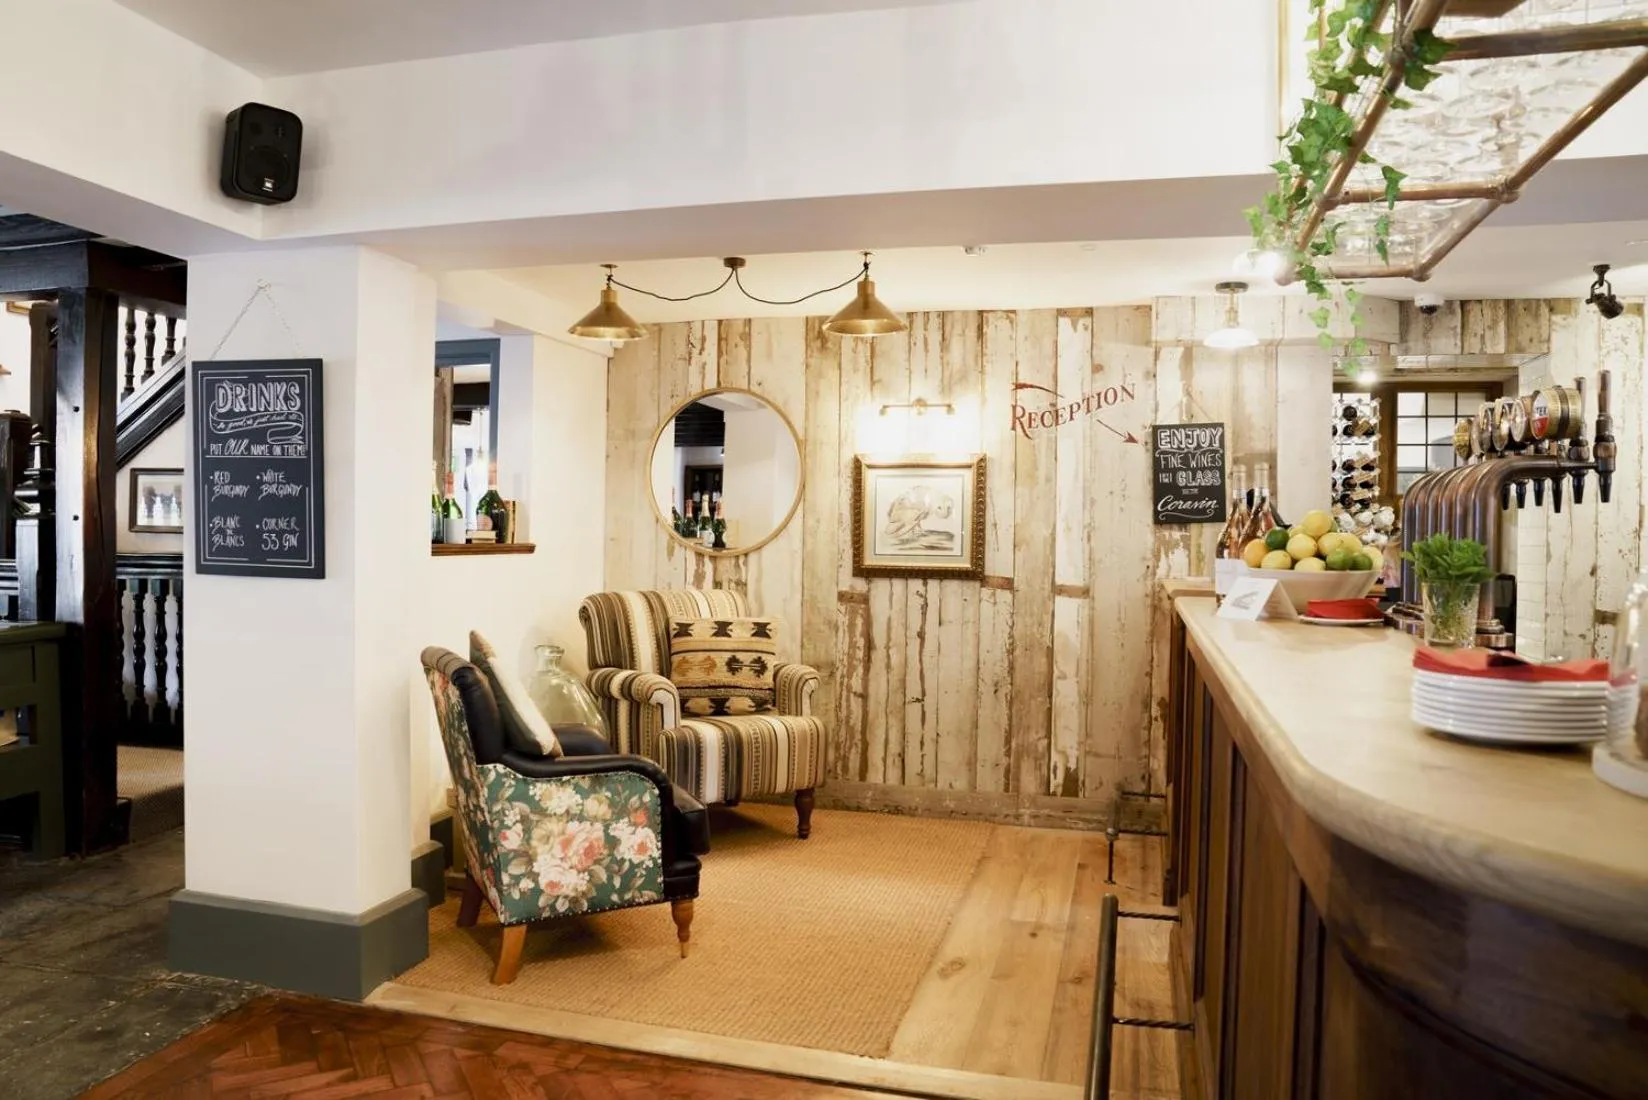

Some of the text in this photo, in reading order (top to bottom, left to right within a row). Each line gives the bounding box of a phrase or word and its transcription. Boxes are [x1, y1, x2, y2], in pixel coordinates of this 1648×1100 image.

[215, 381, 301, 412] DRINKS
[1158, 427, 1222, 448] ENJOY
[250, 444, 271, 456] NAME
[272, 444, 282, 456] ON
[283, 443, 306, 457] THEM
[1160, 453, 1222, 469] FINE WINES
[1176, 469, 1222, 487] GLASS
[261, 533, 280, 551] 53
